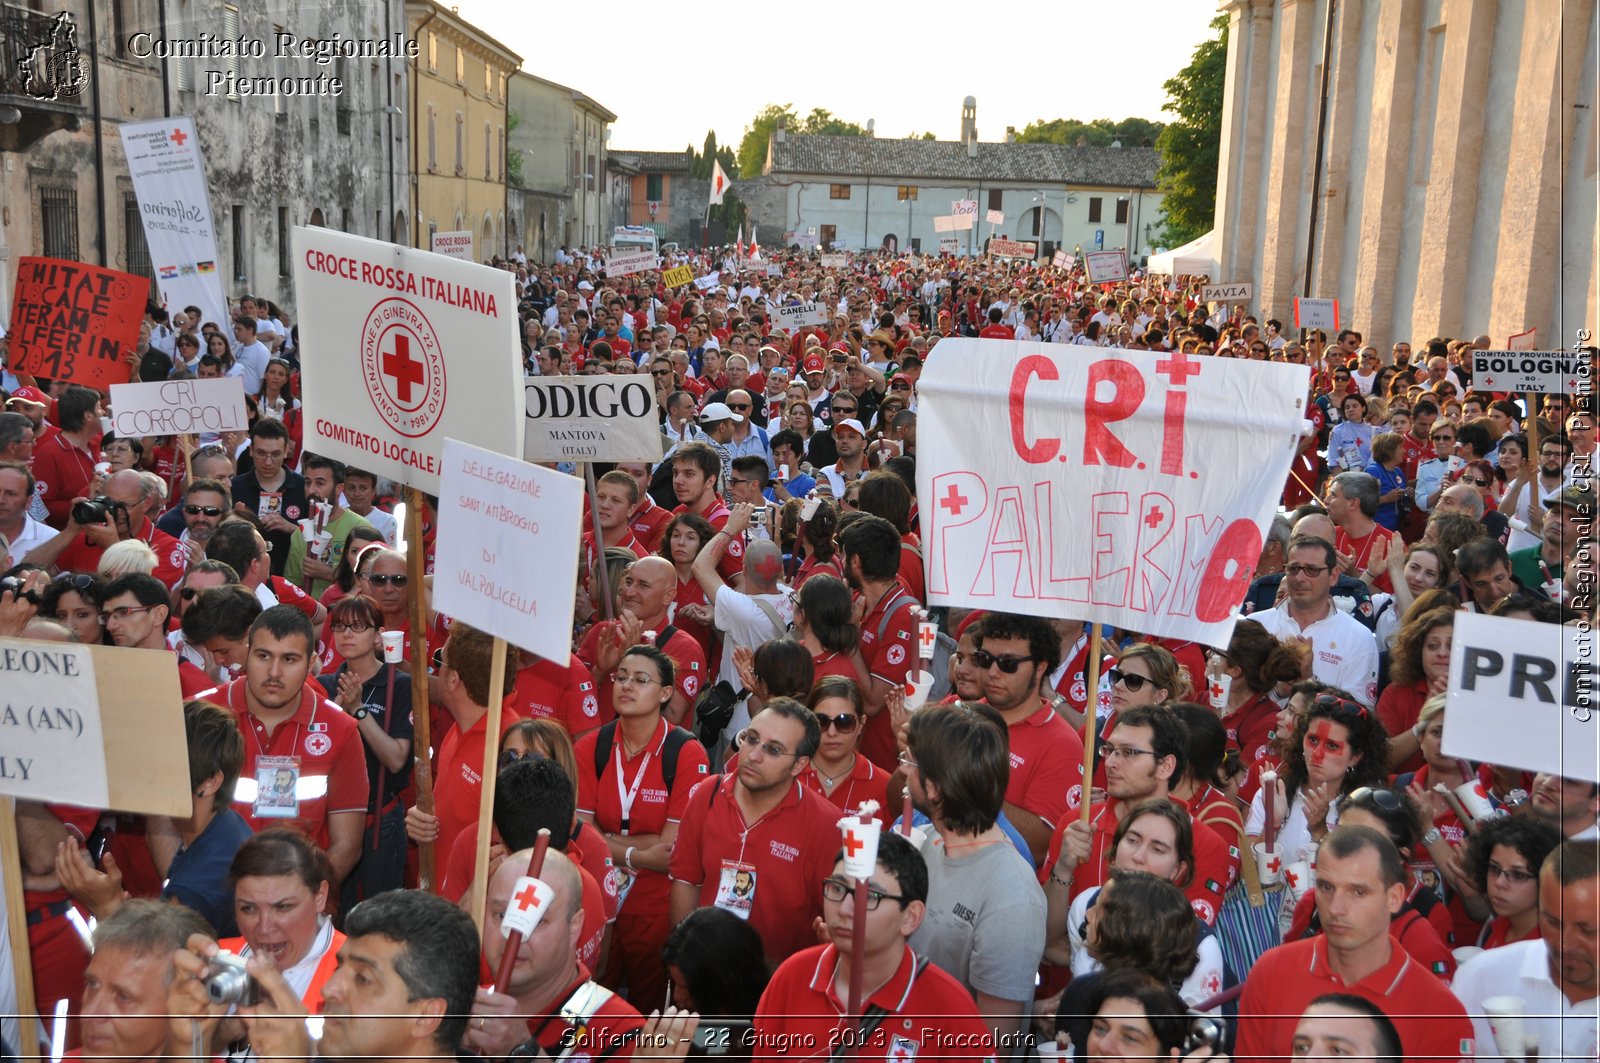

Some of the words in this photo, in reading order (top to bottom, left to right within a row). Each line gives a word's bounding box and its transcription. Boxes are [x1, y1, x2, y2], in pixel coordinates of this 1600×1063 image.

[435, 237, 453, 247] CROCE
[454, 236, 472, 246] ROSSA
[305, 249, 359, 282] CROCE
[362, 261, 417, 295] ROSSA
[421, 275, 498, 318] ITALIANA
[665, 268, 693, 287] IVREA
[1205, 287, 1248, 299] PAVIA
[373, 314, 384, 330] DI
[383, 306, 424, 334] GINEVRA
[780, 304, 817, 316] CANELLI
[423, 332, 434, 350] 22
[14, 344, 76, 380] 2013
[366, 326, 401, 424] CONVENZIONE
[160, 380, 198, 406] CRI
[429, 353, 442, 415] AGOSTO
[117, 404, 240, 436] CORROPOLI
[409, 411, 430, 430] 1864
[316, 418, 381, 455] COMITATO
[383, 440, 435, 474] LOCALE
[549, 430, 606, 442] MANTOVA
[562, 445, 598, 457] (ITALY)
[462, 459, 542, 499] DELEGAZIONE
[482, 548, 496, 565] DI
[928, 471, 1264, 624] PALERMO
[27, 705, 84, 738] (AN)
